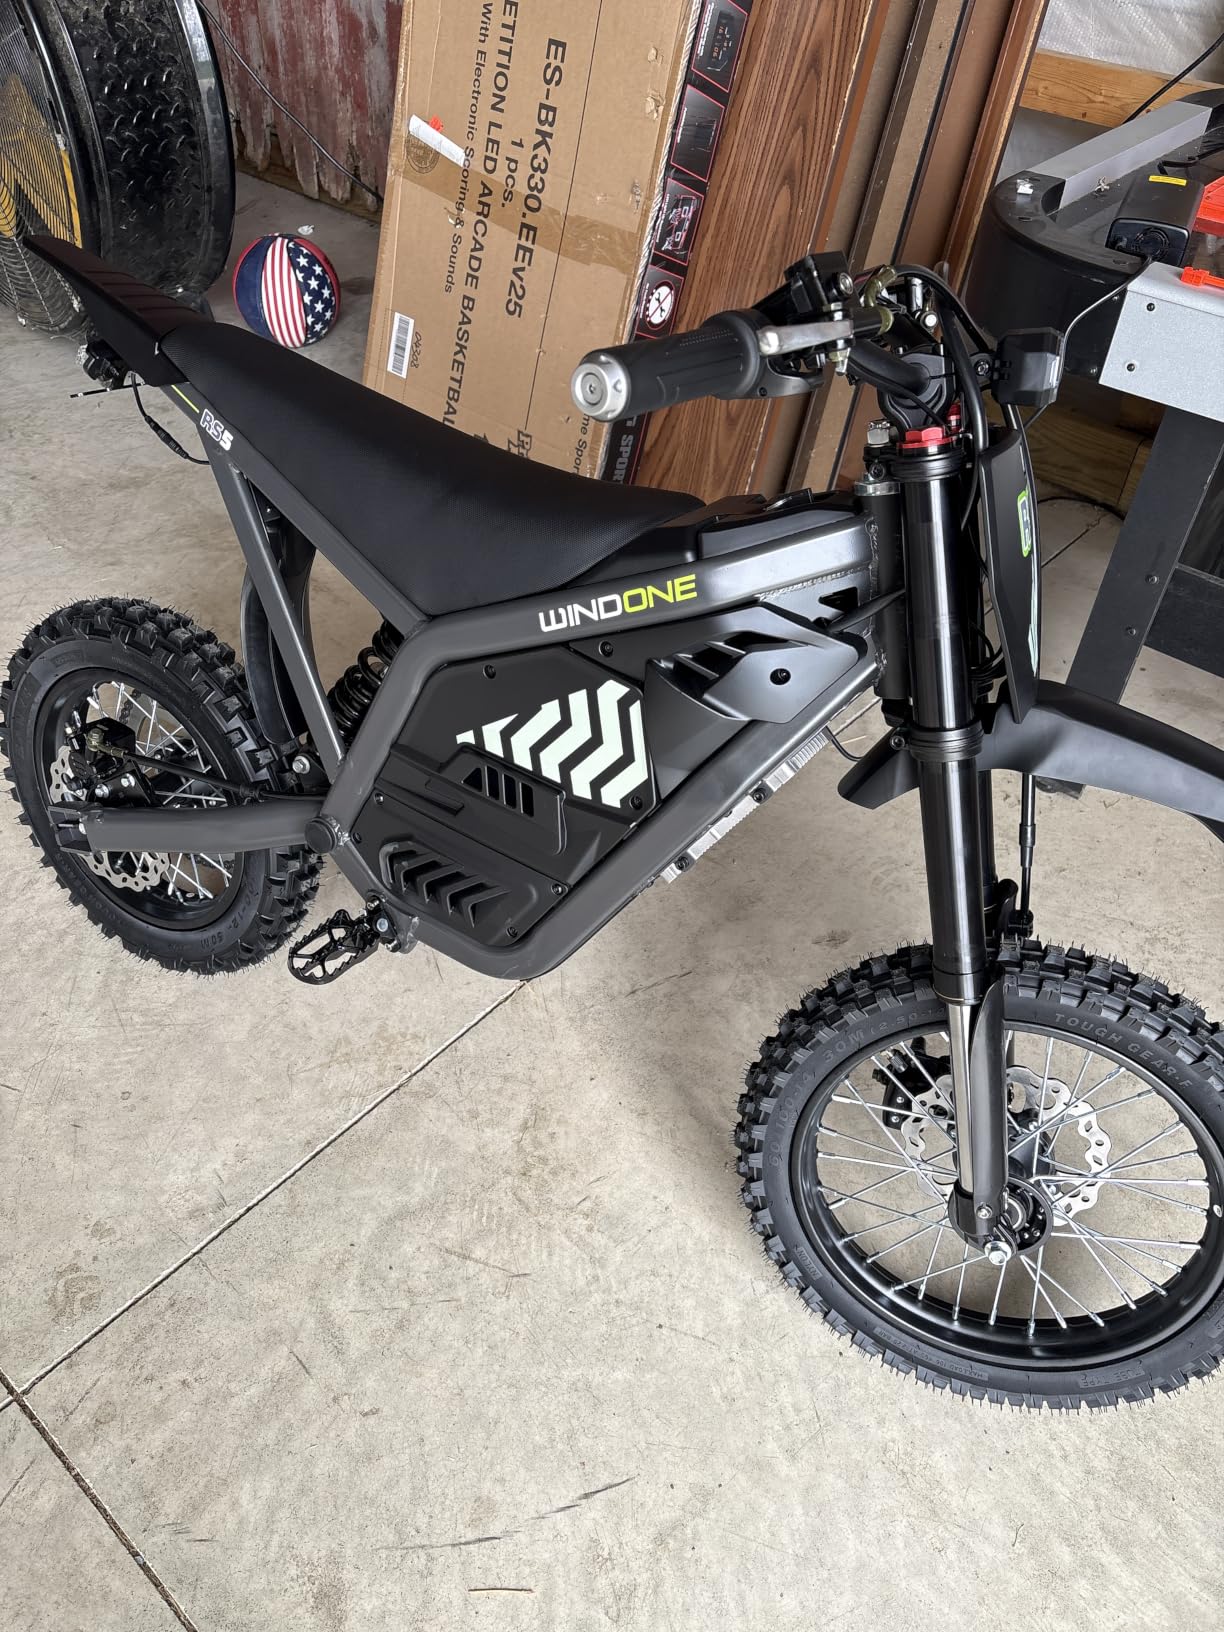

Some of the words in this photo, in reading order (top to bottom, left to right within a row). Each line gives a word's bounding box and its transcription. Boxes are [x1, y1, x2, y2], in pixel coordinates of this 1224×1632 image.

[479, 2, 493, 43] With
[490, 0, 519, 113] ETITION
[466, 50, 487, 141] Electronic
[483, 120, 503, 175] LED
[510, 138, 524, 149] 1
[455, 146, 475, 212] Scoring
[502, 156, 519, 208] pcs.
[505, 37, 567, 318] ES-BK330.EEv25
[454, 218, 465, 230] &
[465, 180, 493, 290] ARCADE
[445, 233, 462, 293] Sounds
[538, 573, 698, 632] WINDONE
[1054, 1013, 1123, 1044] TOUGH
